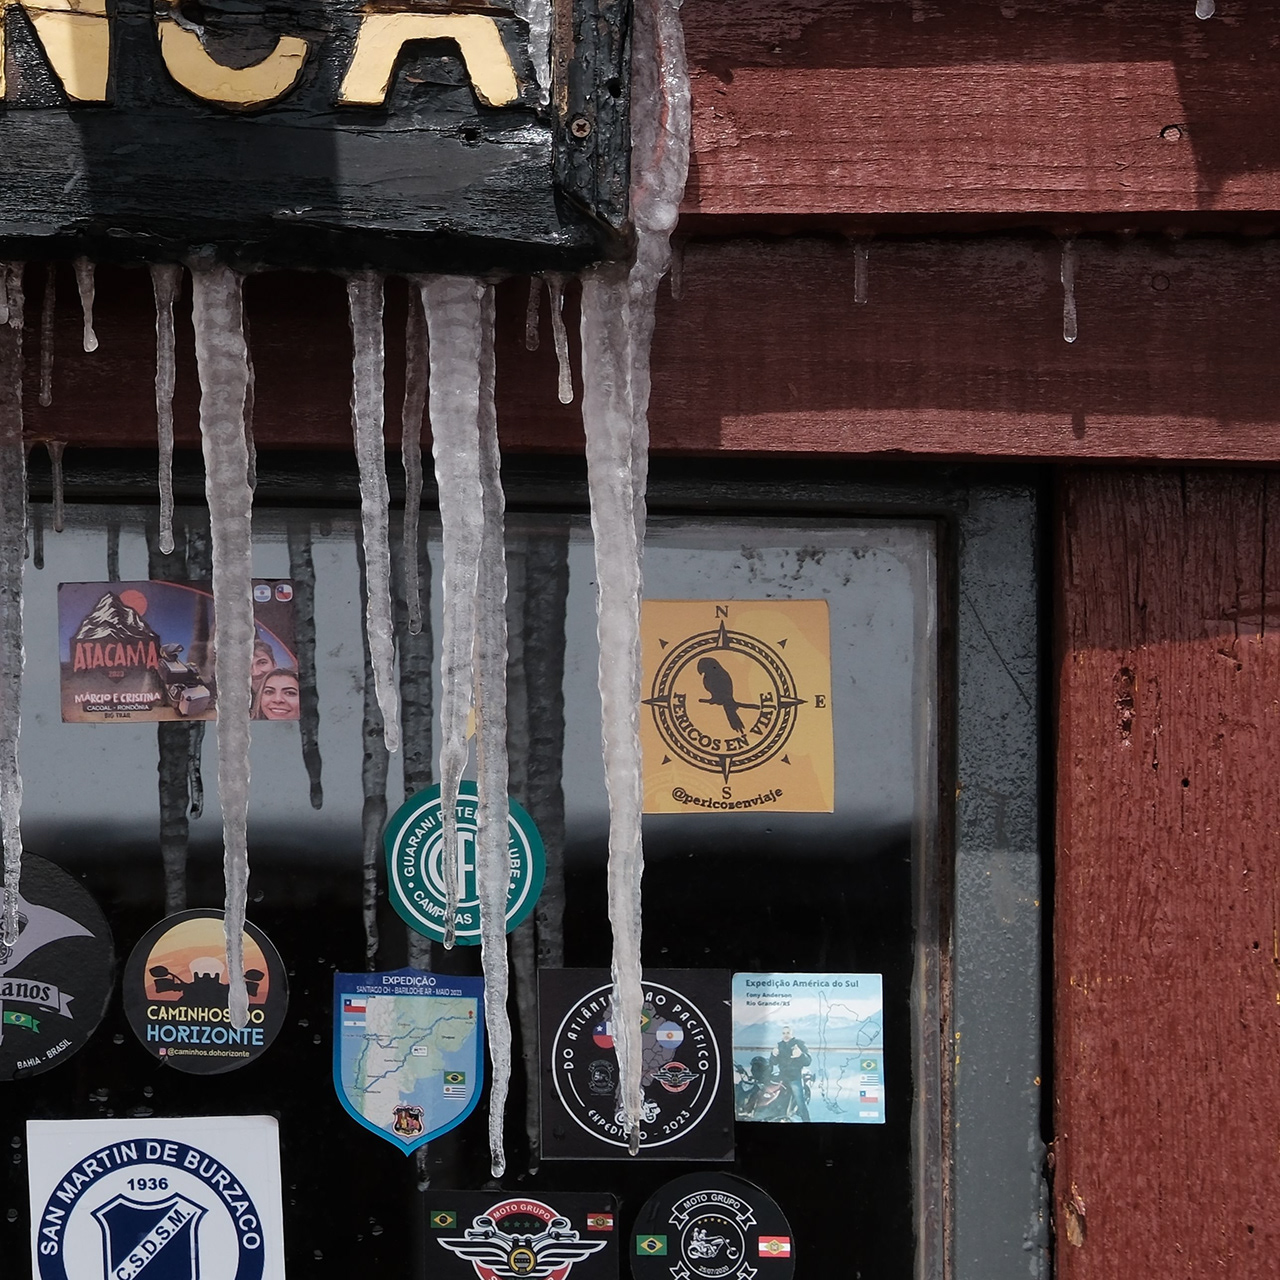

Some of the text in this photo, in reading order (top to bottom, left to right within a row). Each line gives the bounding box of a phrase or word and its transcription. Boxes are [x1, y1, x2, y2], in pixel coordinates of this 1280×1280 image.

[715, 606, 729, 618] N
[74, 641, 159, 672] ATACAMA
[75, 692, 160, 703] MÁRCIO E CRISTINA
[815, 695, 826, 708] E
[673, 692, 779, 751] PERICOS EN VIAJE
[672, 786, 783, 809] @pericosenviaje
[722, 787, 732, 799] S
[404, 816, 435, 877] GUARANI
[382, 976, 436, 986] EXPEDIÇÃO
[746, 979, 790, 989] Expedição
[147, 1006, 230, 1022] CAMINHOS
[147, 1024, 264, 1046] HORIZONTE
[563, 992, 709, 1070] DO AO PACÍFICO
[16, 1039, 72, 1069] BAHIA BRASIL
[168, 1048, 249, 1057] @caminhos.dohorizonte
[663, 1110, 690, 1134] 2023
[127, 1178, 169, 1191] 1936
[41, 1142, 260, 1255] SAN MARTIN DE BURZACO
[683, 1194, 740, 1209] MOTO GRUPO
[493, 1205, 551, 1219] MOTO GRUPO
[116, 1208, 191, 1280] C.S.D.S.M.
